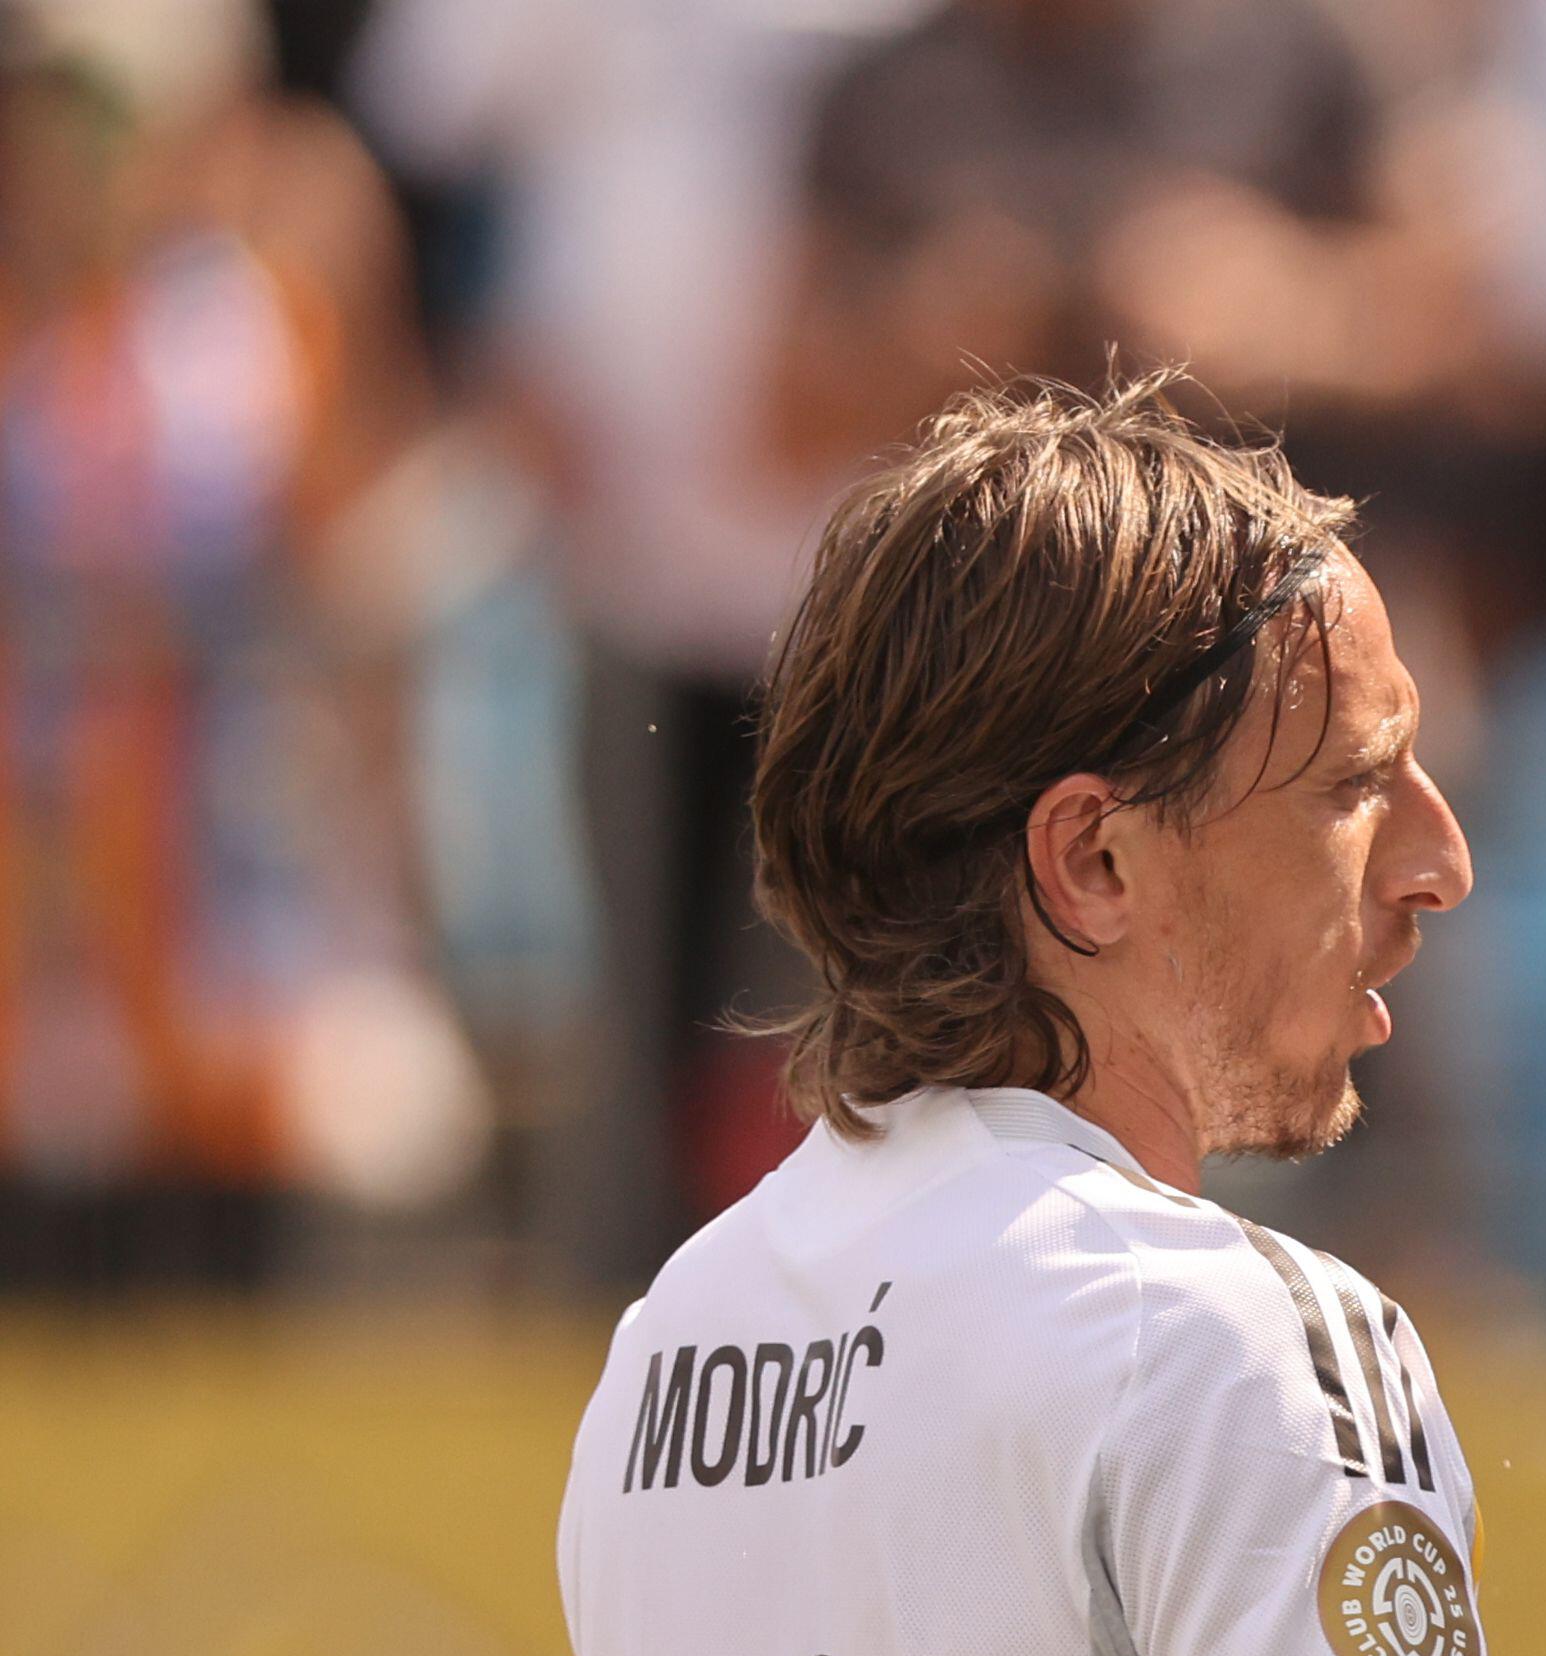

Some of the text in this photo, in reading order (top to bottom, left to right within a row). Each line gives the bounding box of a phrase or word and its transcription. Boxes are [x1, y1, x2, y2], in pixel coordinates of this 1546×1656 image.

[622, 1281, 893, 1494] MODRIĆ
[1342, 1525, 1407, 1586] WORLD
[1412, 1533, 1447, 1575] CUP
[1444, 1585, 1464, 1619] 25
